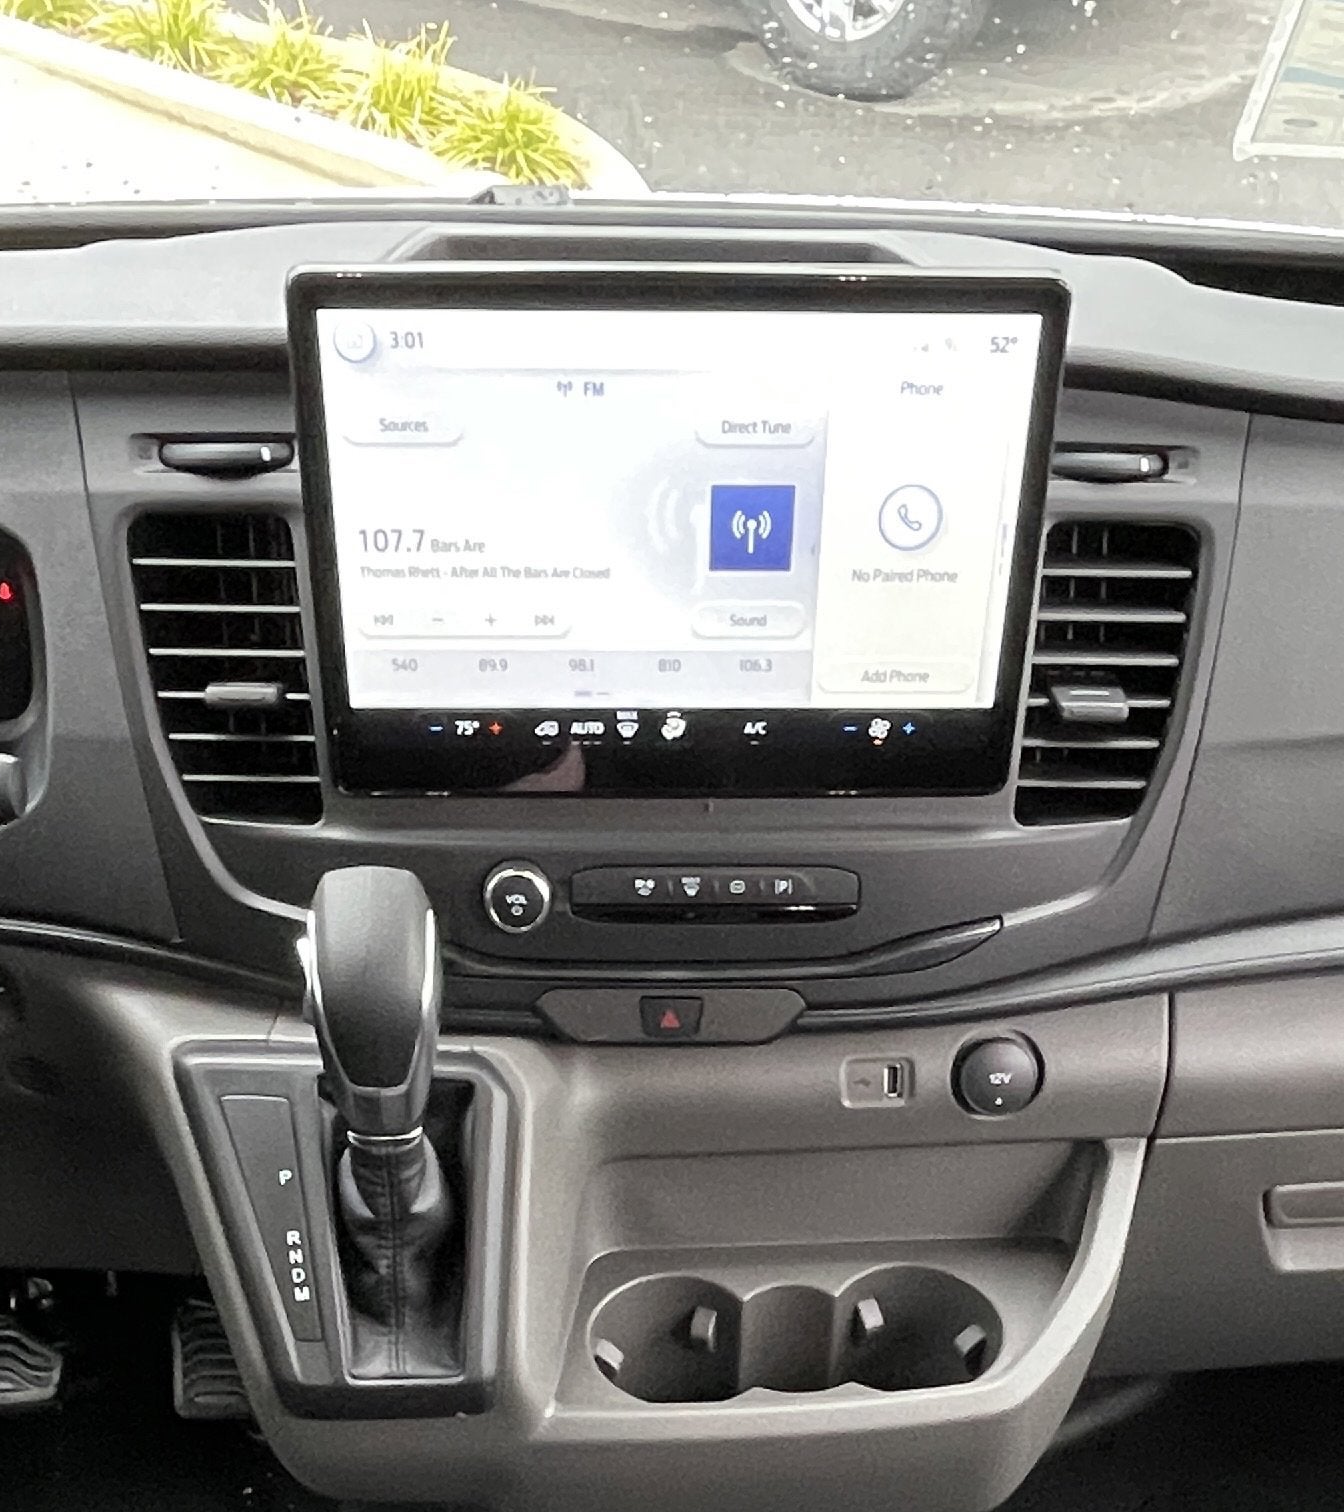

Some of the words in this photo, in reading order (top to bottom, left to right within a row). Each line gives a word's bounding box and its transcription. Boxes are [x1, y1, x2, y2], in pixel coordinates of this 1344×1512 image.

[389, 331, 425, 349] 3:01
[583, 381, 605, 397] FM
[900, 381, 944, 396] Phone
[379, 417, 430, 434] Sources
[721, 420, 758, 434] Direct
[761, 420, 792, 434] Tune
[359, 529, 425, 553] 107.7
[430, 538, 460, 553] Bars
[463, 538, 486, 553] Are
[360, 566, 407, 580] Thomas
[501, 566, 522, 580] The
[851, 568, 870, 583] No
[872, 568, 914, 583] Paired
[917, 568, 959, 583] Phone
[729, 613, 768, 627] Sound
[568, 658, 595, 672] 98.1
[860, 670, 888, 684] Add
[889, 670, 930, 684] Phone
[569, 721, 606, 736] AUTO
[743, 721, 768, 736] A/C
[278, 1169, 293, 1186] P
